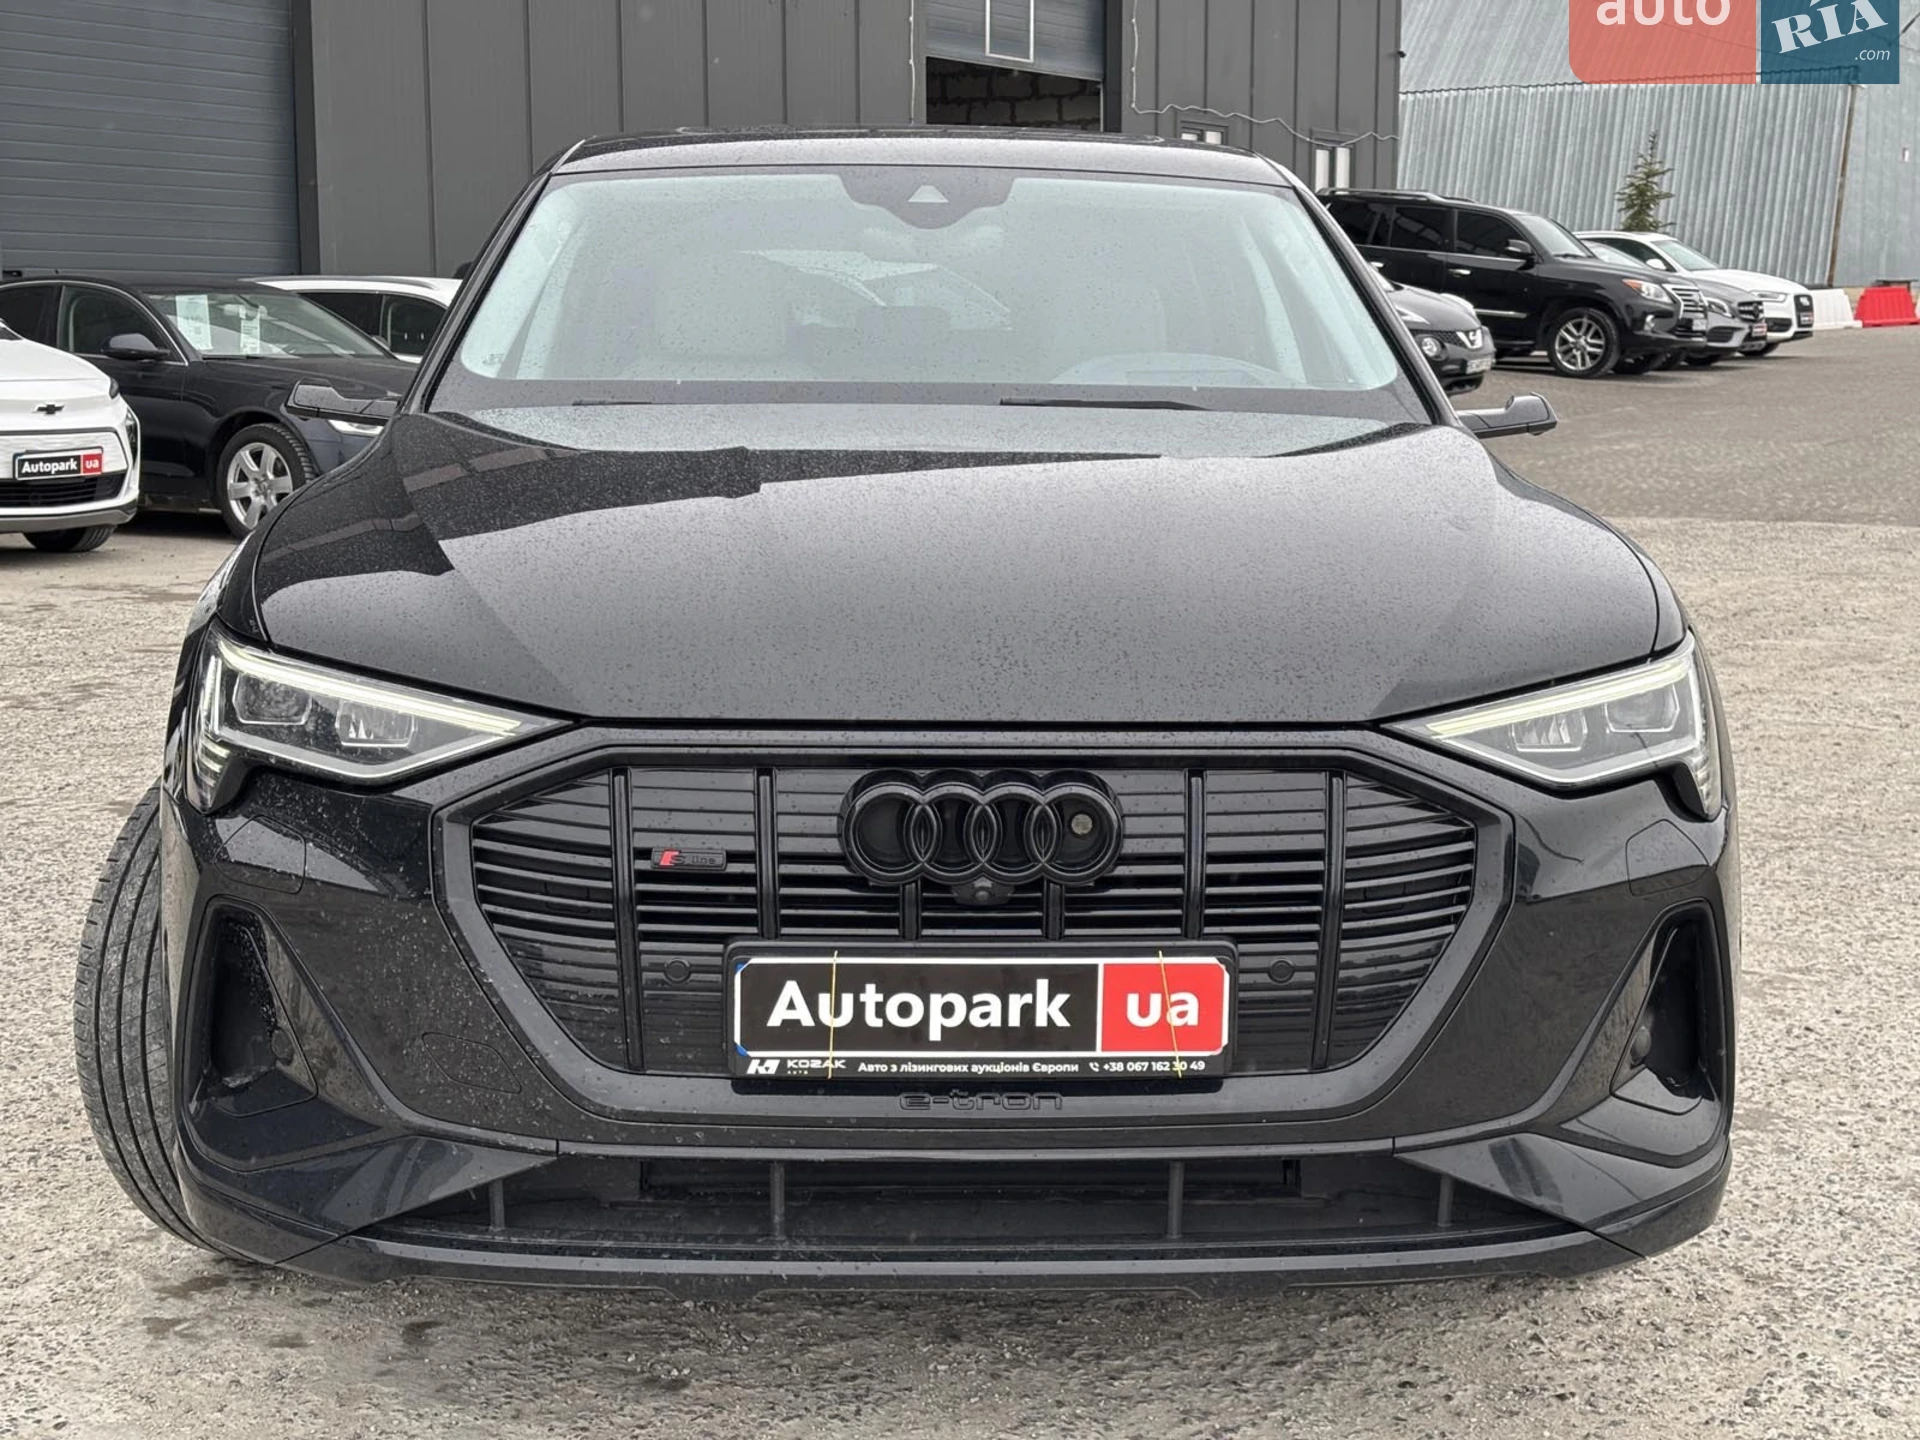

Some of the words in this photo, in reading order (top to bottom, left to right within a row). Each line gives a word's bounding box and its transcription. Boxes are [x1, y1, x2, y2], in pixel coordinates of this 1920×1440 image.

[21, 458, 78, 474] Autopark
[85, 459, 99, 469] ua
[766, 979, 1072, 1042] Autopark
[1126, 990, 1200, 1027] ua
[858, 1062, 888, 1073] Авто
[899, 1061, 969, 1075] лізингових
[970, 1061, 1030, 1075] аукціонів
[1032, 1062, 1079, 1074] Європи
[1103, 1061, 1125, 1072] +38
[1126, 1061, 1149, 1072] 067
[1151, 1061, 1171, 1072] 162
[1189, 1061, 1206, 1070] 49
[900, 1090, 1063, 1110] e-tron
